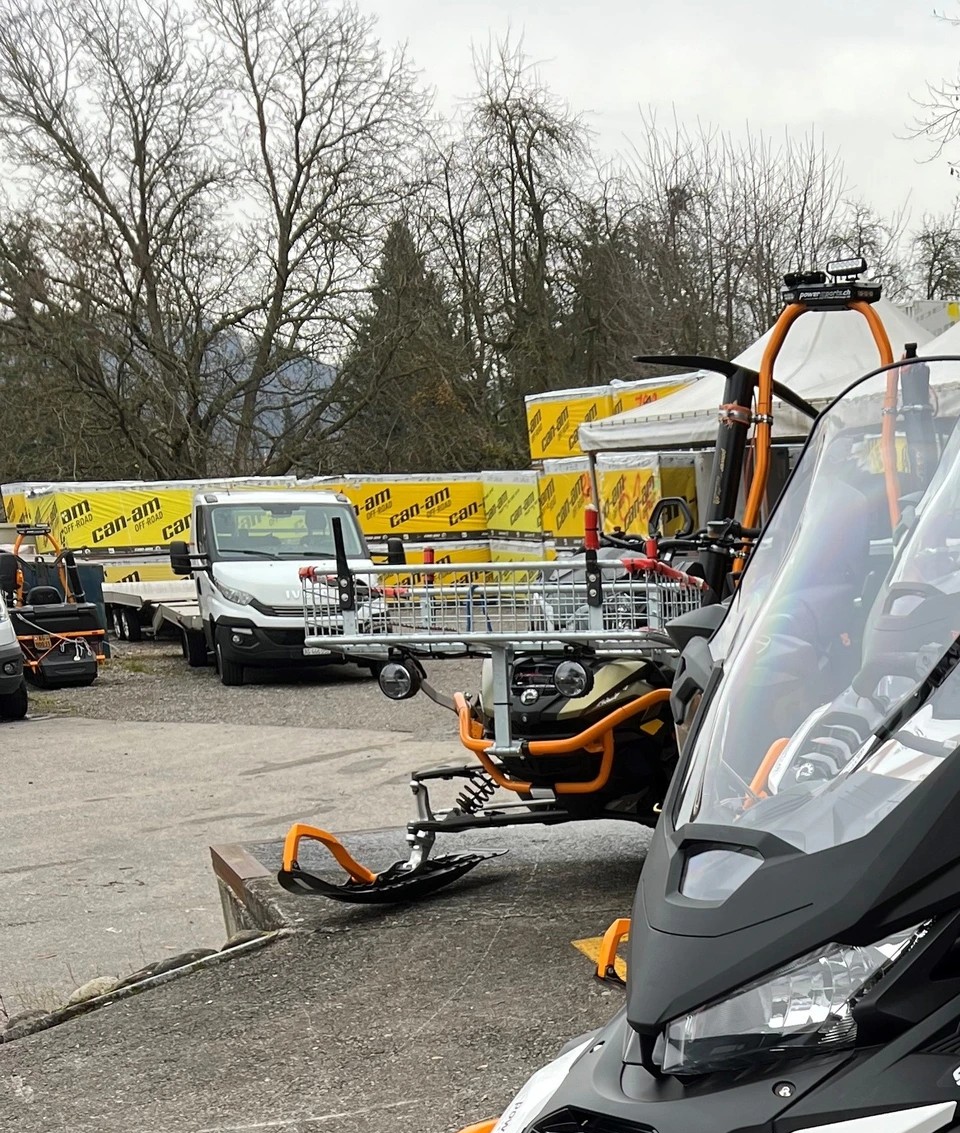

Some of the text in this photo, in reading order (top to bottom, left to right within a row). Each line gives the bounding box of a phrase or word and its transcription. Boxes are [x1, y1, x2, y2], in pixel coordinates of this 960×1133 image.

[353, 488, 391, 517] n-am
[389, 487, 450, 528] can-am
[449, 502, 485, 527] can-
[92, 497, 161, 544] can-am
[162, 513, 192, 541] can
